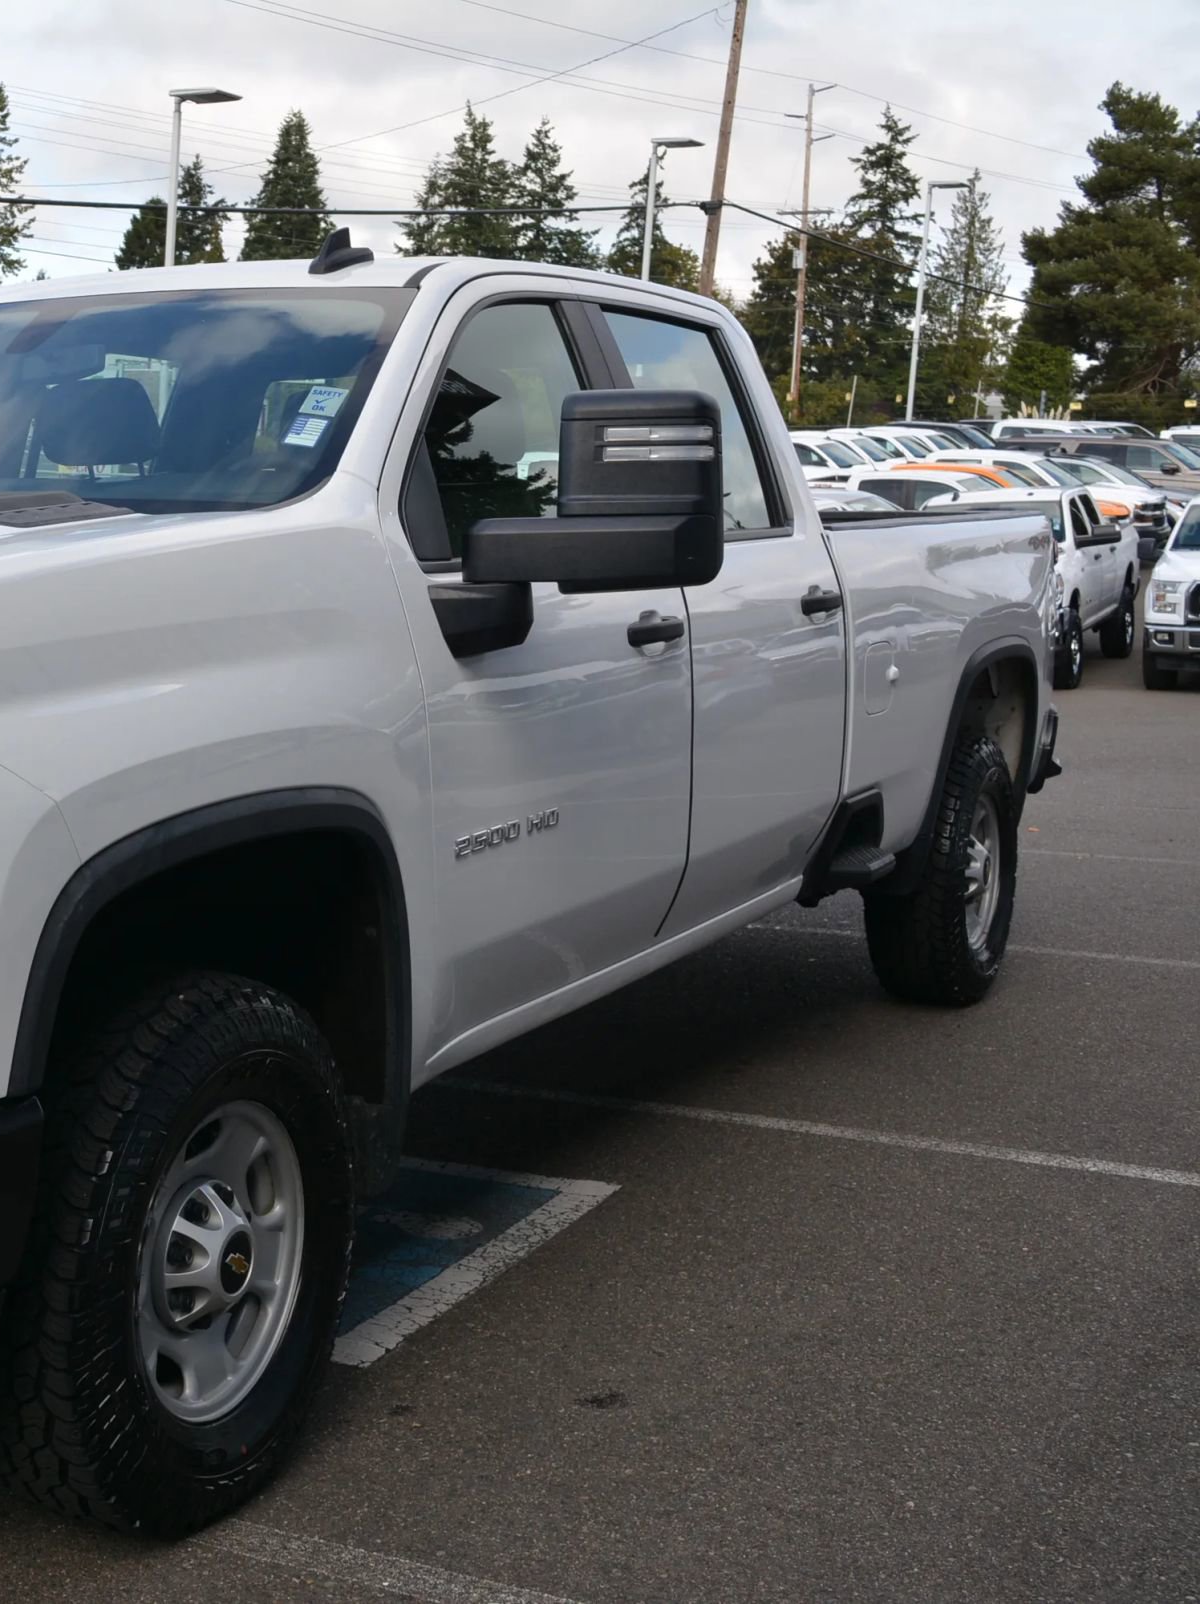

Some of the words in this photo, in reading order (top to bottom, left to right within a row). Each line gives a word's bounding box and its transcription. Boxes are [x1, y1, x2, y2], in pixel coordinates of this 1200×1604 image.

[312, 389, 343, 398] SAFETY
[311, 404, 326, 412] OK
[454, 819, 521, 860] 2500
[527, 807, 560, 834] HD
